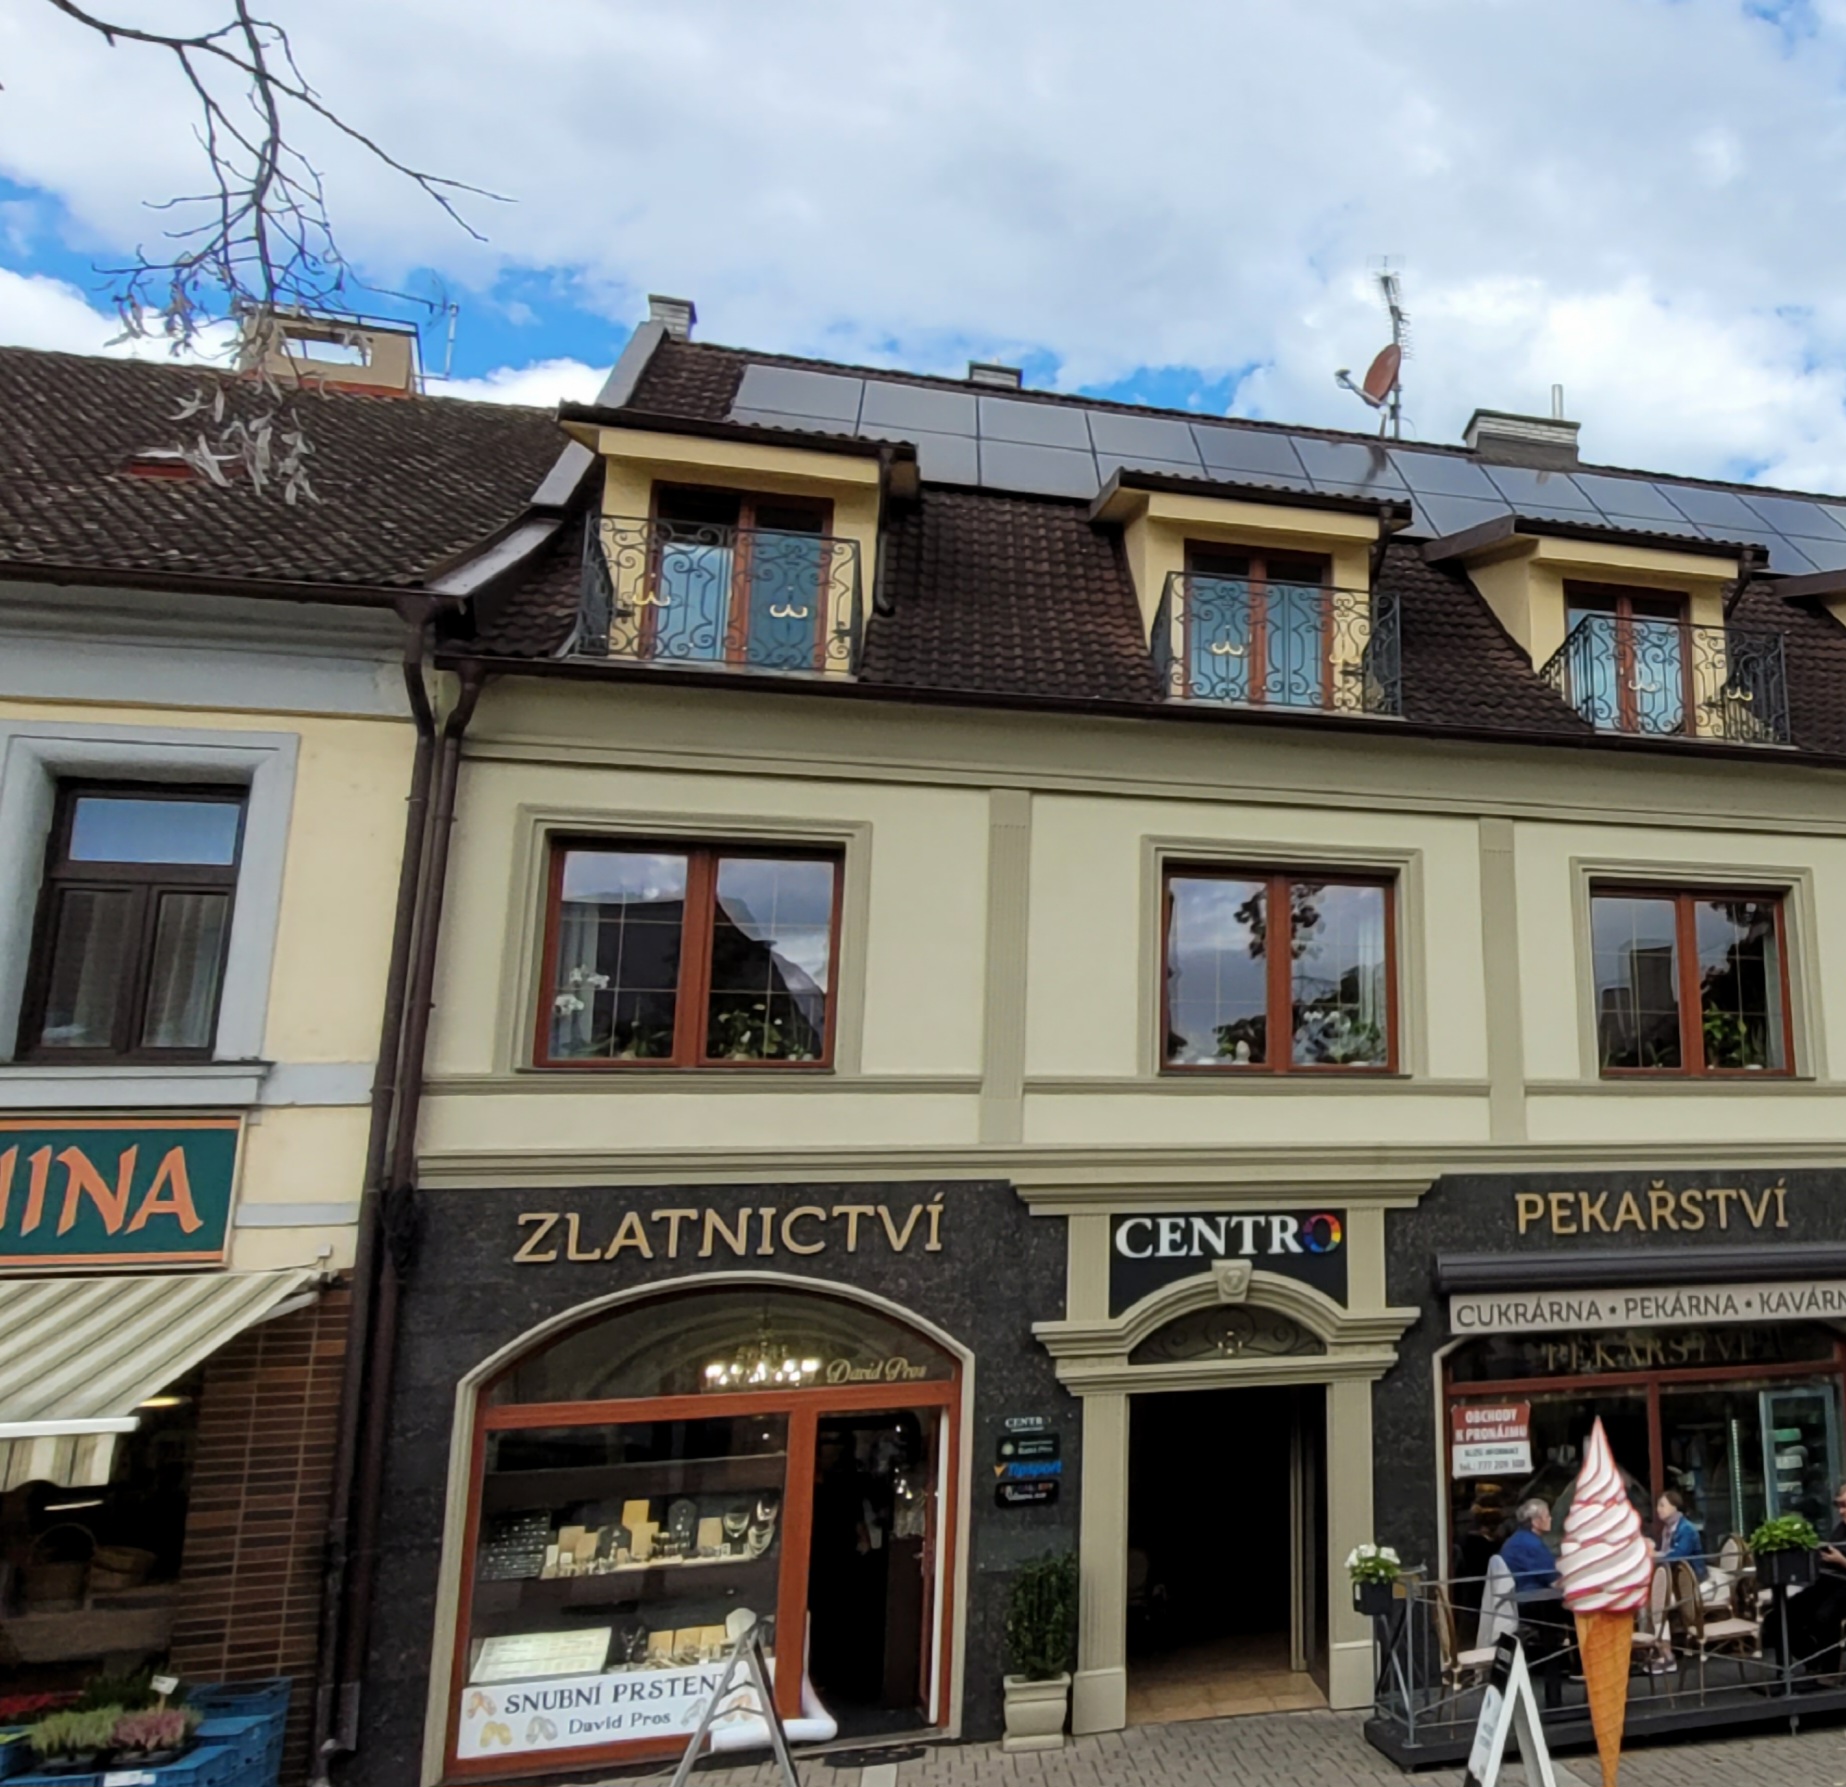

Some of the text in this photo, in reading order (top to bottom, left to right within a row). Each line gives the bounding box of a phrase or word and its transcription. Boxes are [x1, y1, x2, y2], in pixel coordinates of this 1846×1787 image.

[1514, 1178, 1790, 1235] PEKAŘSTVÍ
[512, 1192, 944, 1263] ZLATNICTVÍ
[1115, 1213, 1342, 1259] CENTRO
[1456, 1294, 1603, 1328] CUKRÁRNA
[1624, 1288, 1739, 1320] PEKÁRNA
[826, 1358, 884, 1384] David
[504, 1685, 603, 1714] SNUBNÍ
[568, 1711, 672, 1735] David Pros
